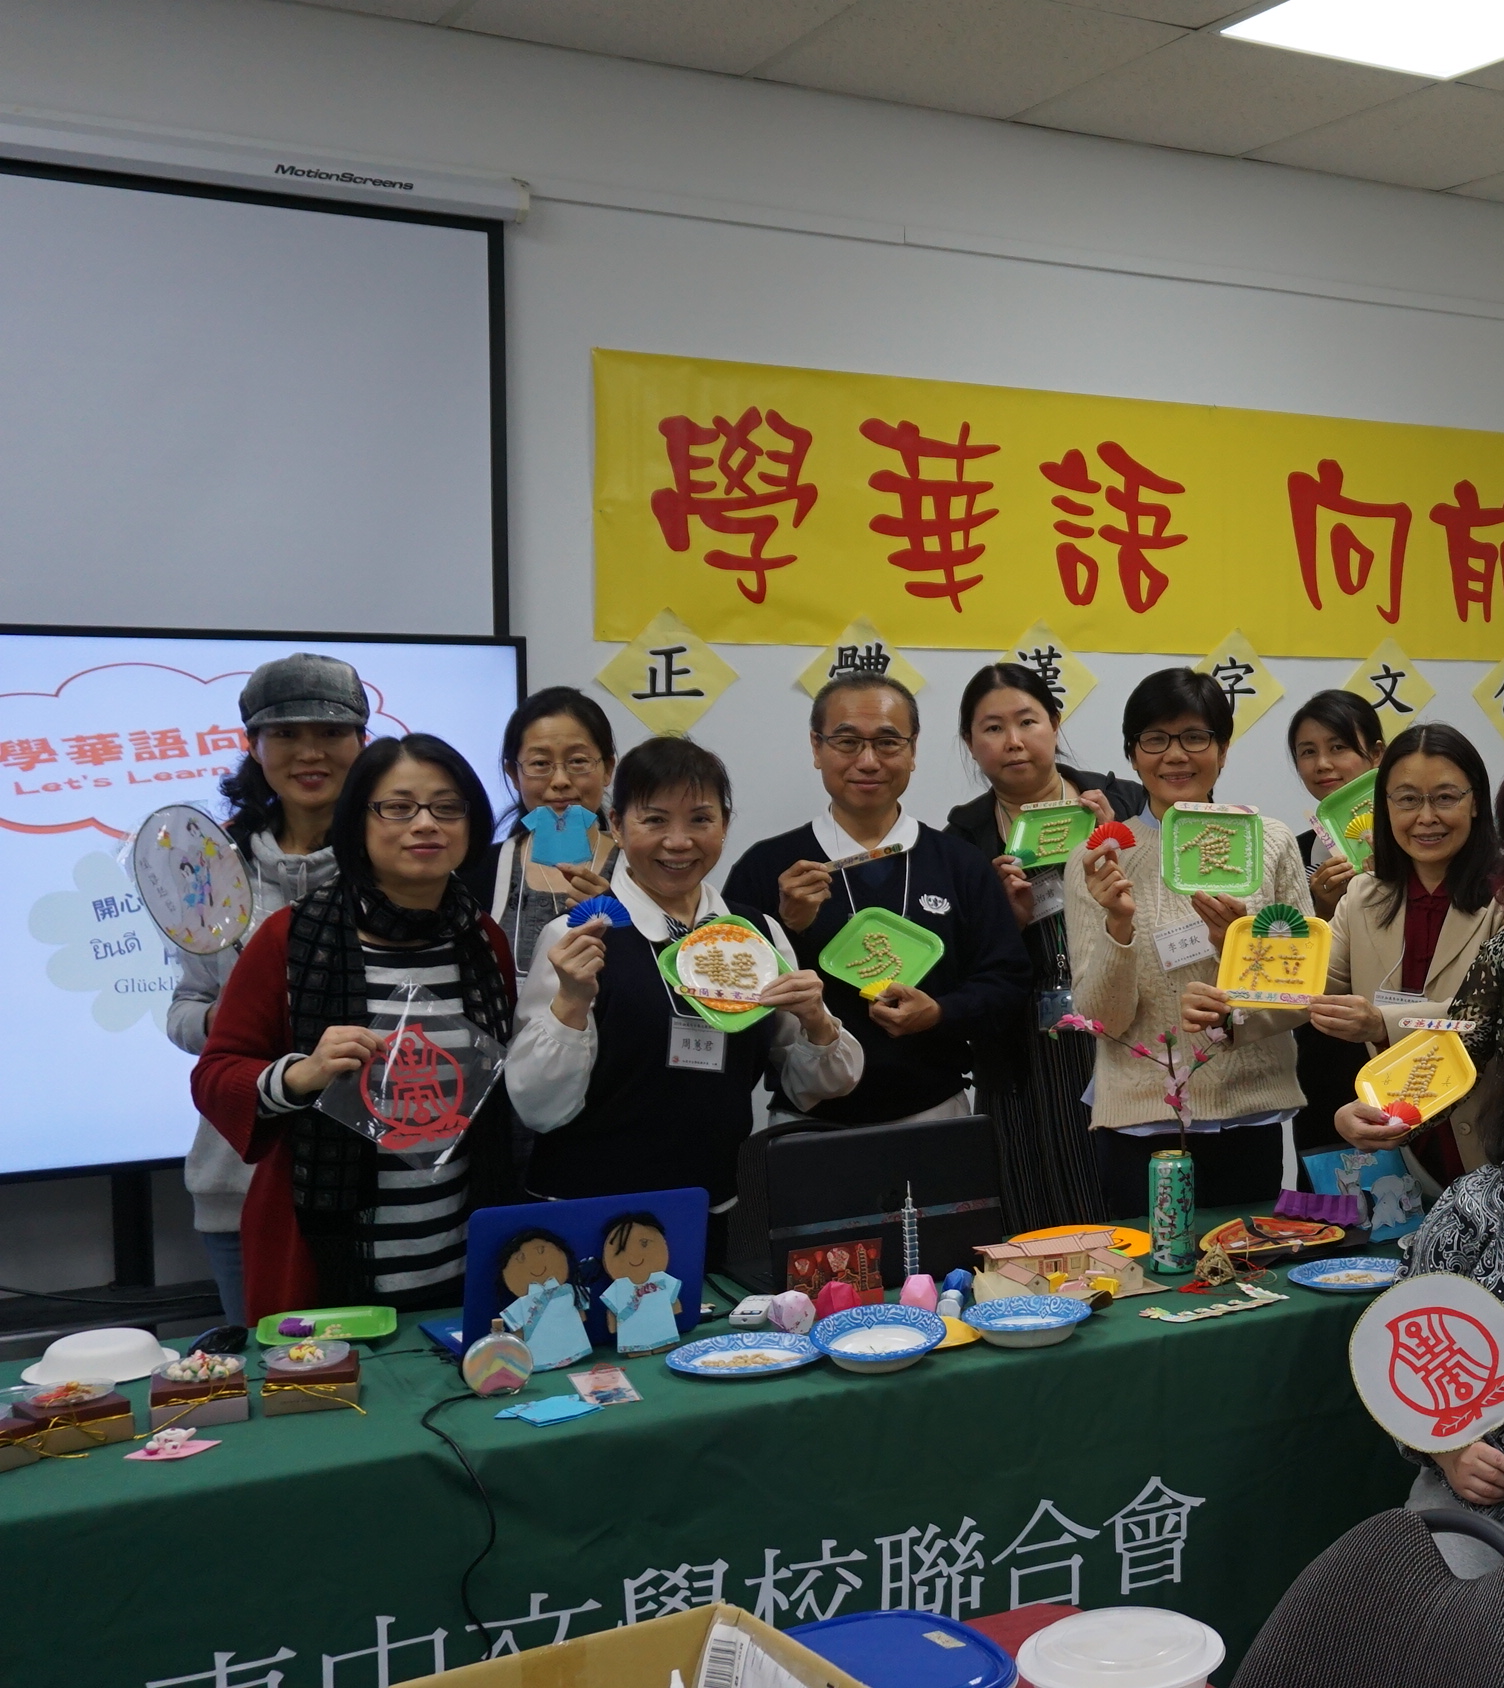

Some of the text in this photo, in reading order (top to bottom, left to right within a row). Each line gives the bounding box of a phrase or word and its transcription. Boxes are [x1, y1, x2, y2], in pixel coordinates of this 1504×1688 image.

[274, 164, 414, 191] MotionScreens
[651, 406, 1188, 614] 學華語
[13, 766, 232, 795] Let's Learn
[92, 893, 144, 922] 開心
[90, 930, 142, 960] ยินดี
